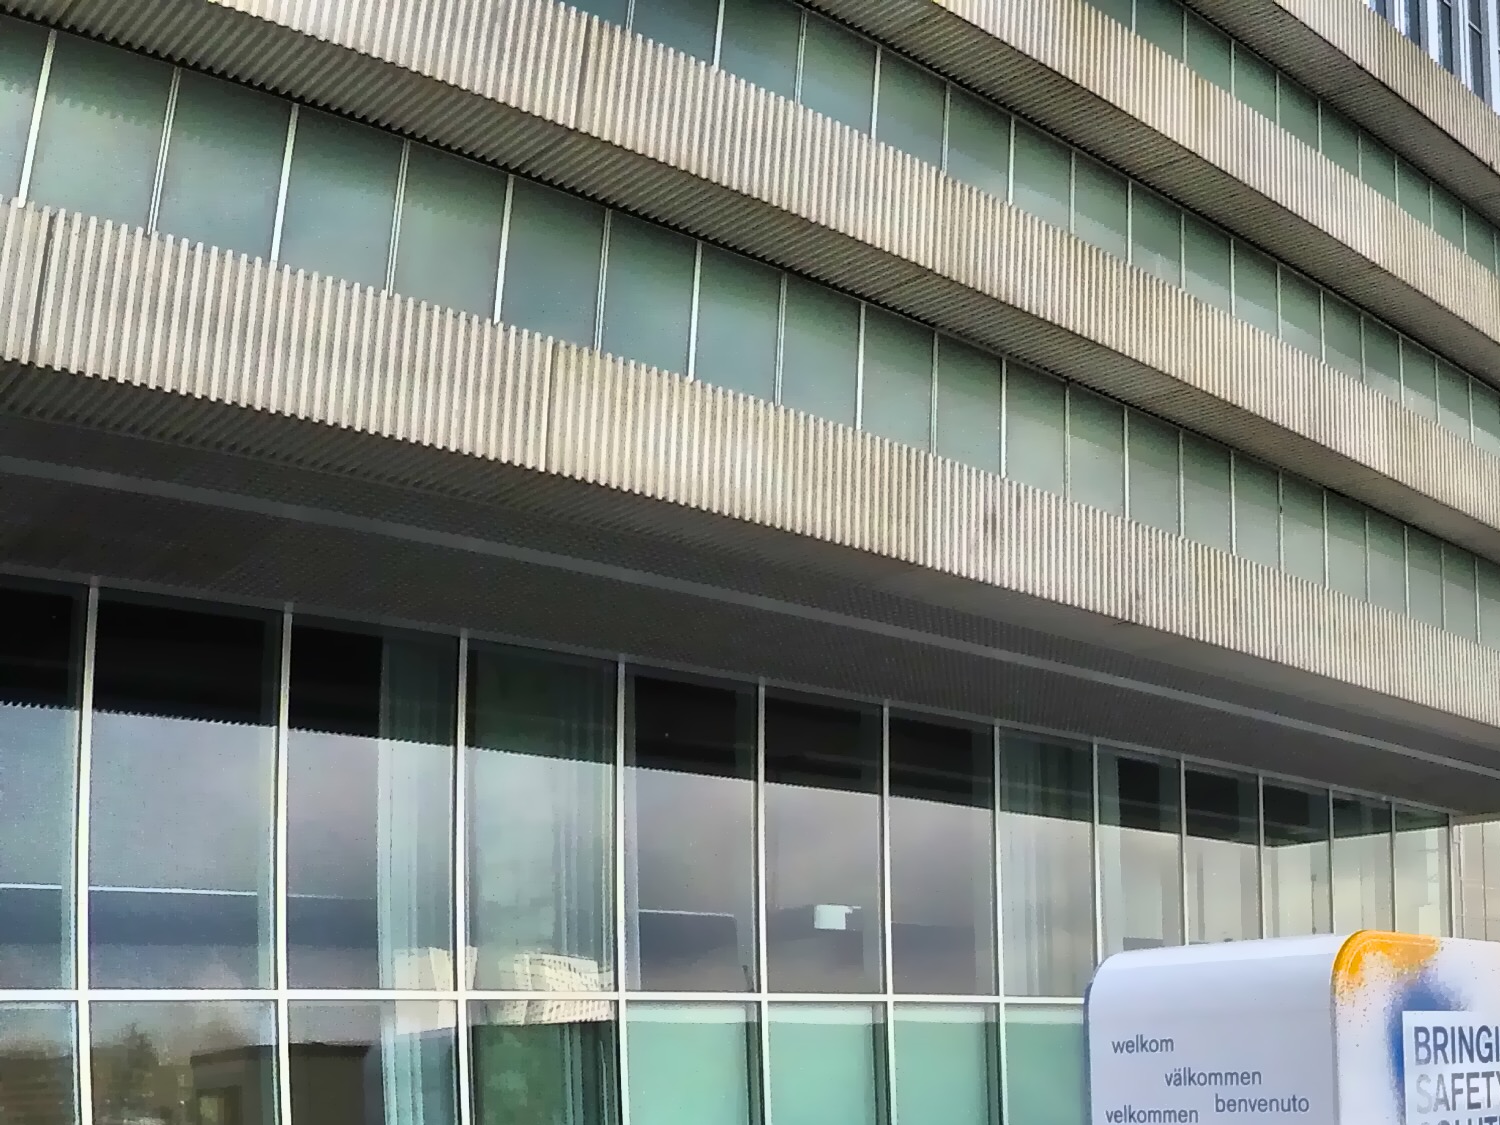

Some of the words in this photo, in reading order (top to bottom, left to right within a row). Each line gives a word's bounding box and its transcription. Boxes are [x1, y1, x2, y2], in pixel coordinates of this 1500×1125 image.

[1111, 1034, 1175, 1053] welkom
[1165, 1067, 1262, 1087] välkommen
[1215, 1093, 1310, 1113] benvenuto
[1105, 1105, 1199, 1124] velkommen
